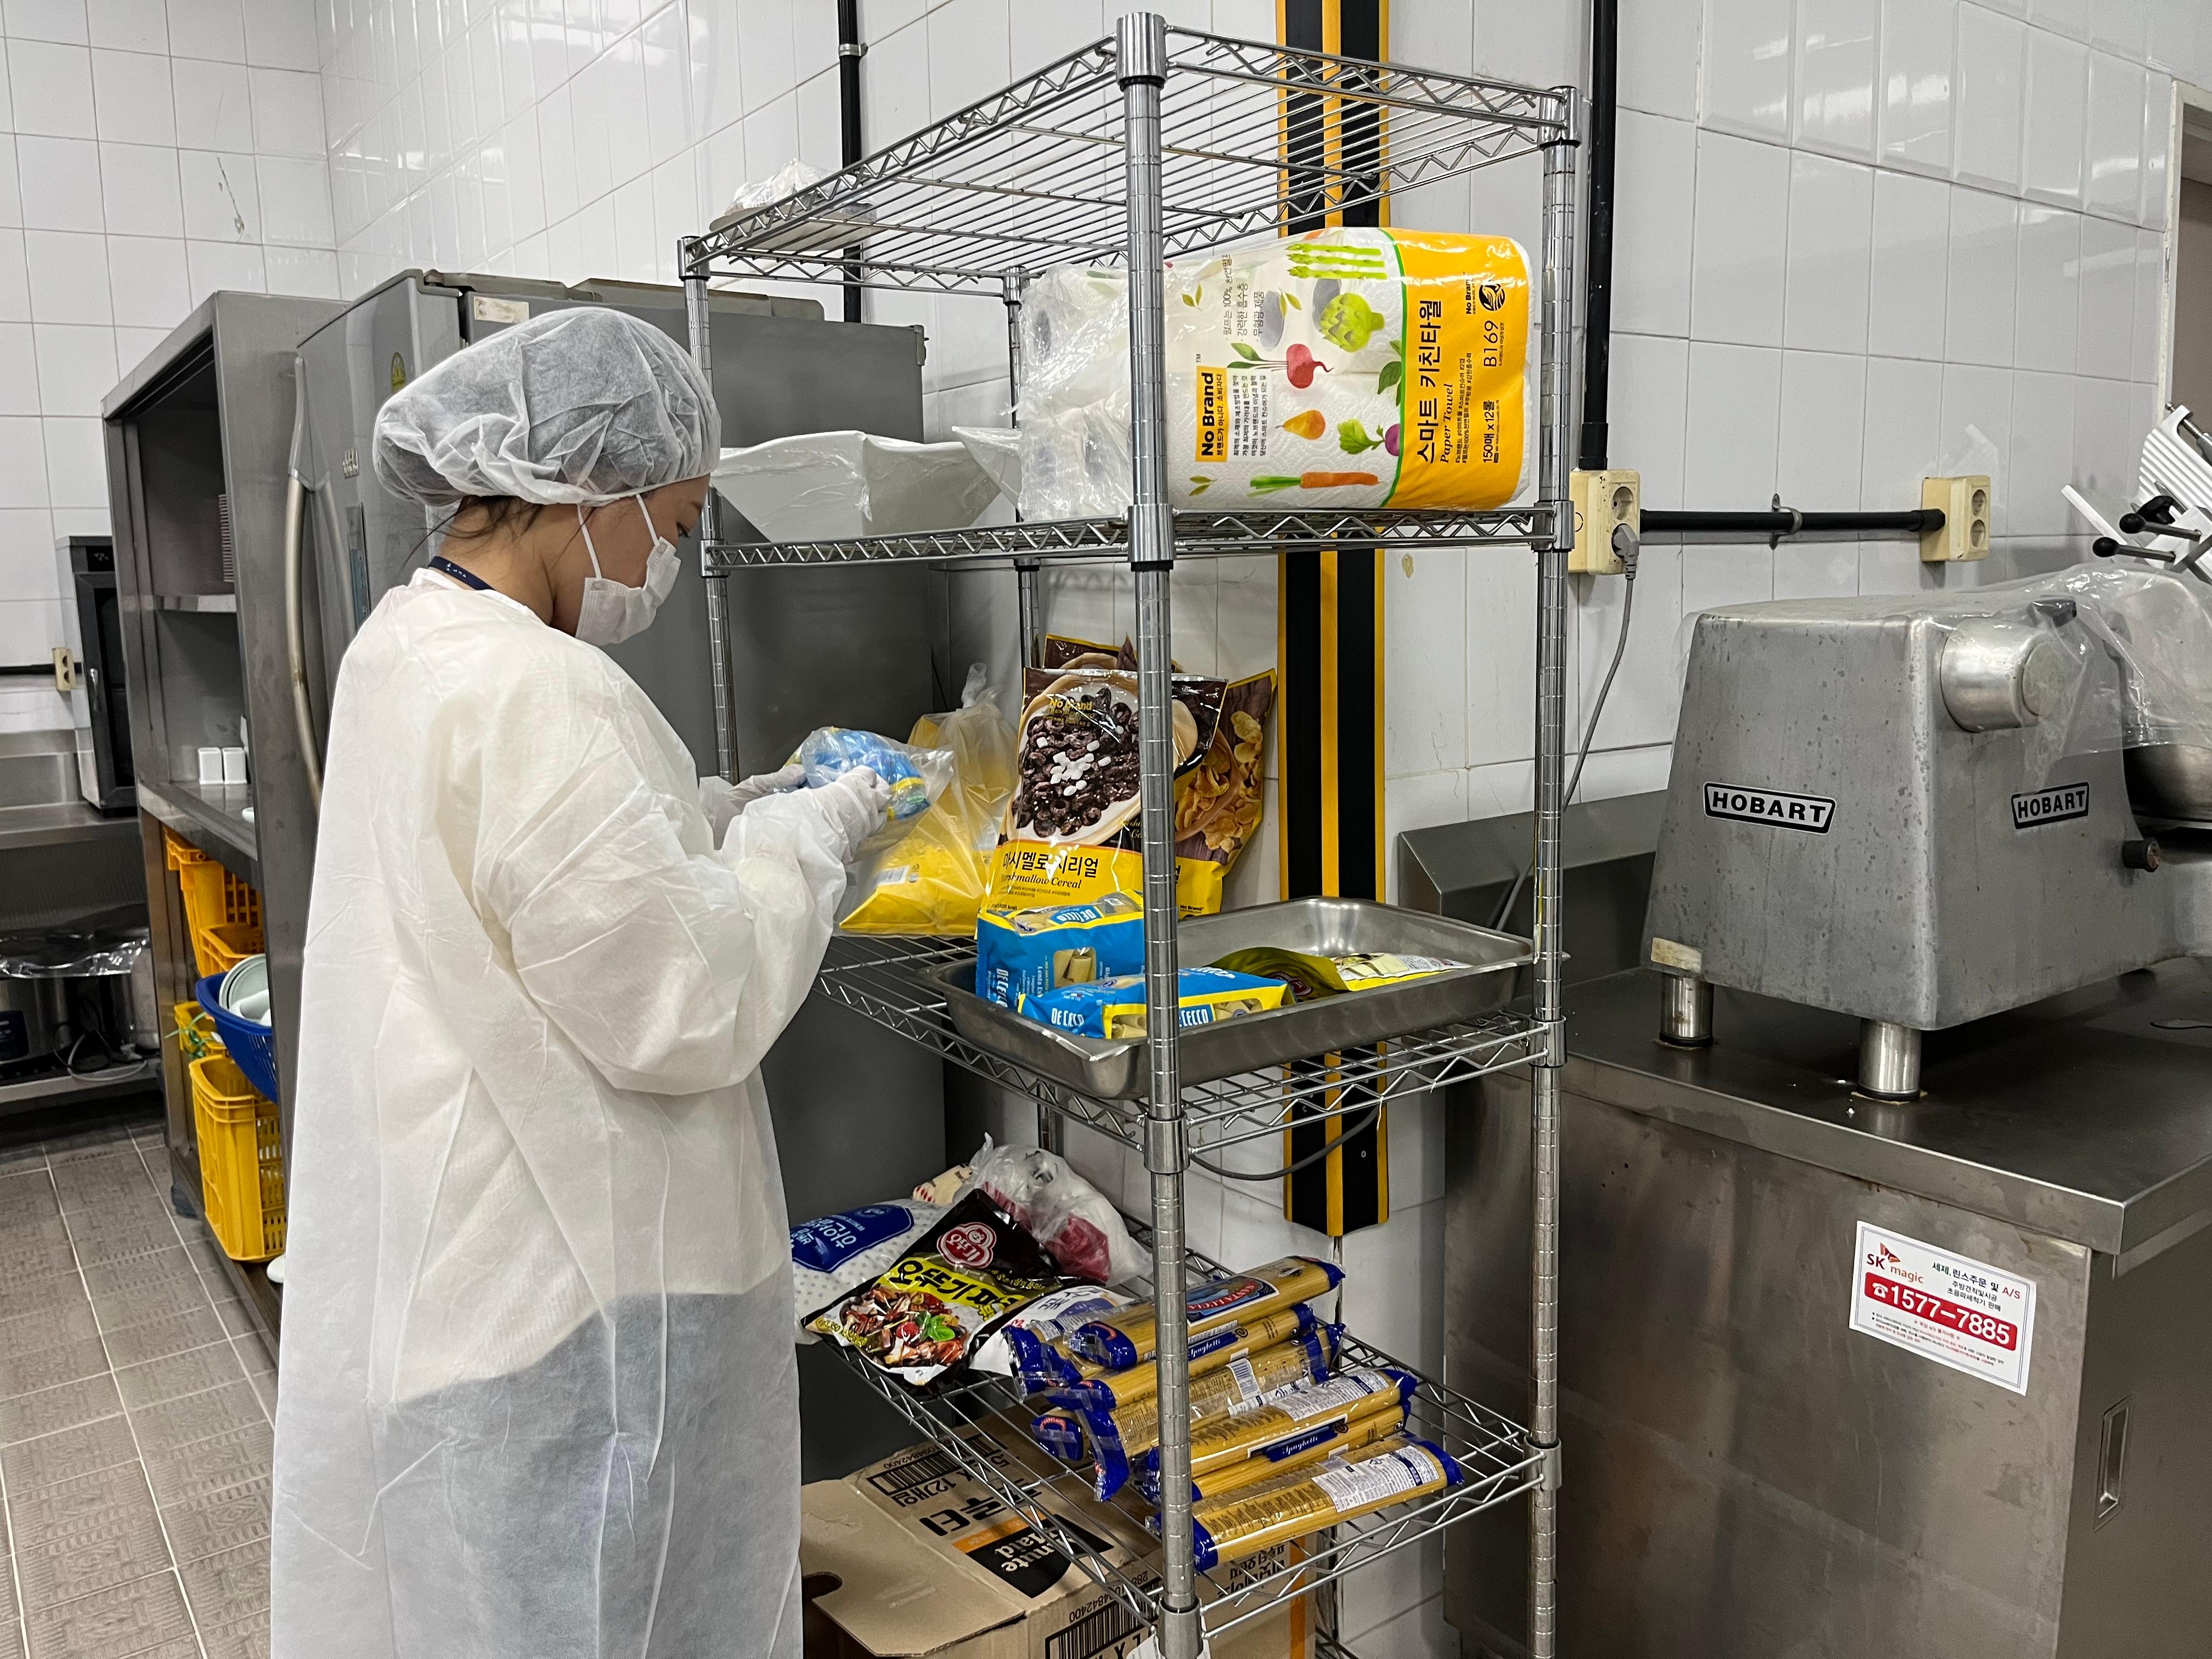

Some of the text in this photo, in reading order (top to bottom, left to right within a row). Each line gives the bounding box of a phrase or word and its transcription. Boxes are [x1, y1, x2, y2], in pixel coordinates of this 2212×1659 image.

[1223, 287, 1232, 307] 100%
[1465, 302, 1471, 314] No
[1223, 311, 1232, 335] 펄프는
[1237, 312, 1248, 336] 강력한
[1253, 291, 1264, 336] 무형광 제품
[1483, 320, 1498, 367] B169
[1417, 300, 1441, 463] 스마트 키친타월
[1201, 372, 1215, 456] No Brand
[1440, 383, 1453, 462] Paper Towel
[1483, 433, 1494, 463] 150매
[1048, 697, 1093, 710] No Band
[1712, 792, 1826, 822] HOBART
[2017, 789, 2085, 819] HOBART
[1003, 851, 1049, 871] 마시멜로
[1051, 877, 1081, 889] Cereal
[1085, 909, 1097, 921] DE
[996, 968, 1009, 981] DE
[1051, 1007, 1062, 1025] DE
[1181, 1009, 1209, 1026] CECCO
[946, 1233, 981, 1261] 오뚜기
[888, 1260, 978, 1301] 오뚜기
[1867, 1253, 1924, 1284] SK magic
[1991, 1282, 1999, 1293] 및
[2002, 1286, 2021, 1300] A/S
[1891, 1285, 2011, 1345] 1577-7885
[1988, 1301, 2001, 1312] 판매
[1188, 1339, 1221, 1358] Spaghetti
[1282, 1436, 1318, 1455] Spaghetti
[890, 1478, 957, 1508] 12개입
[1230, 1556, 1256, 1580] 오렌지
[1069, 1571, 1149, 1623] 288104842400
